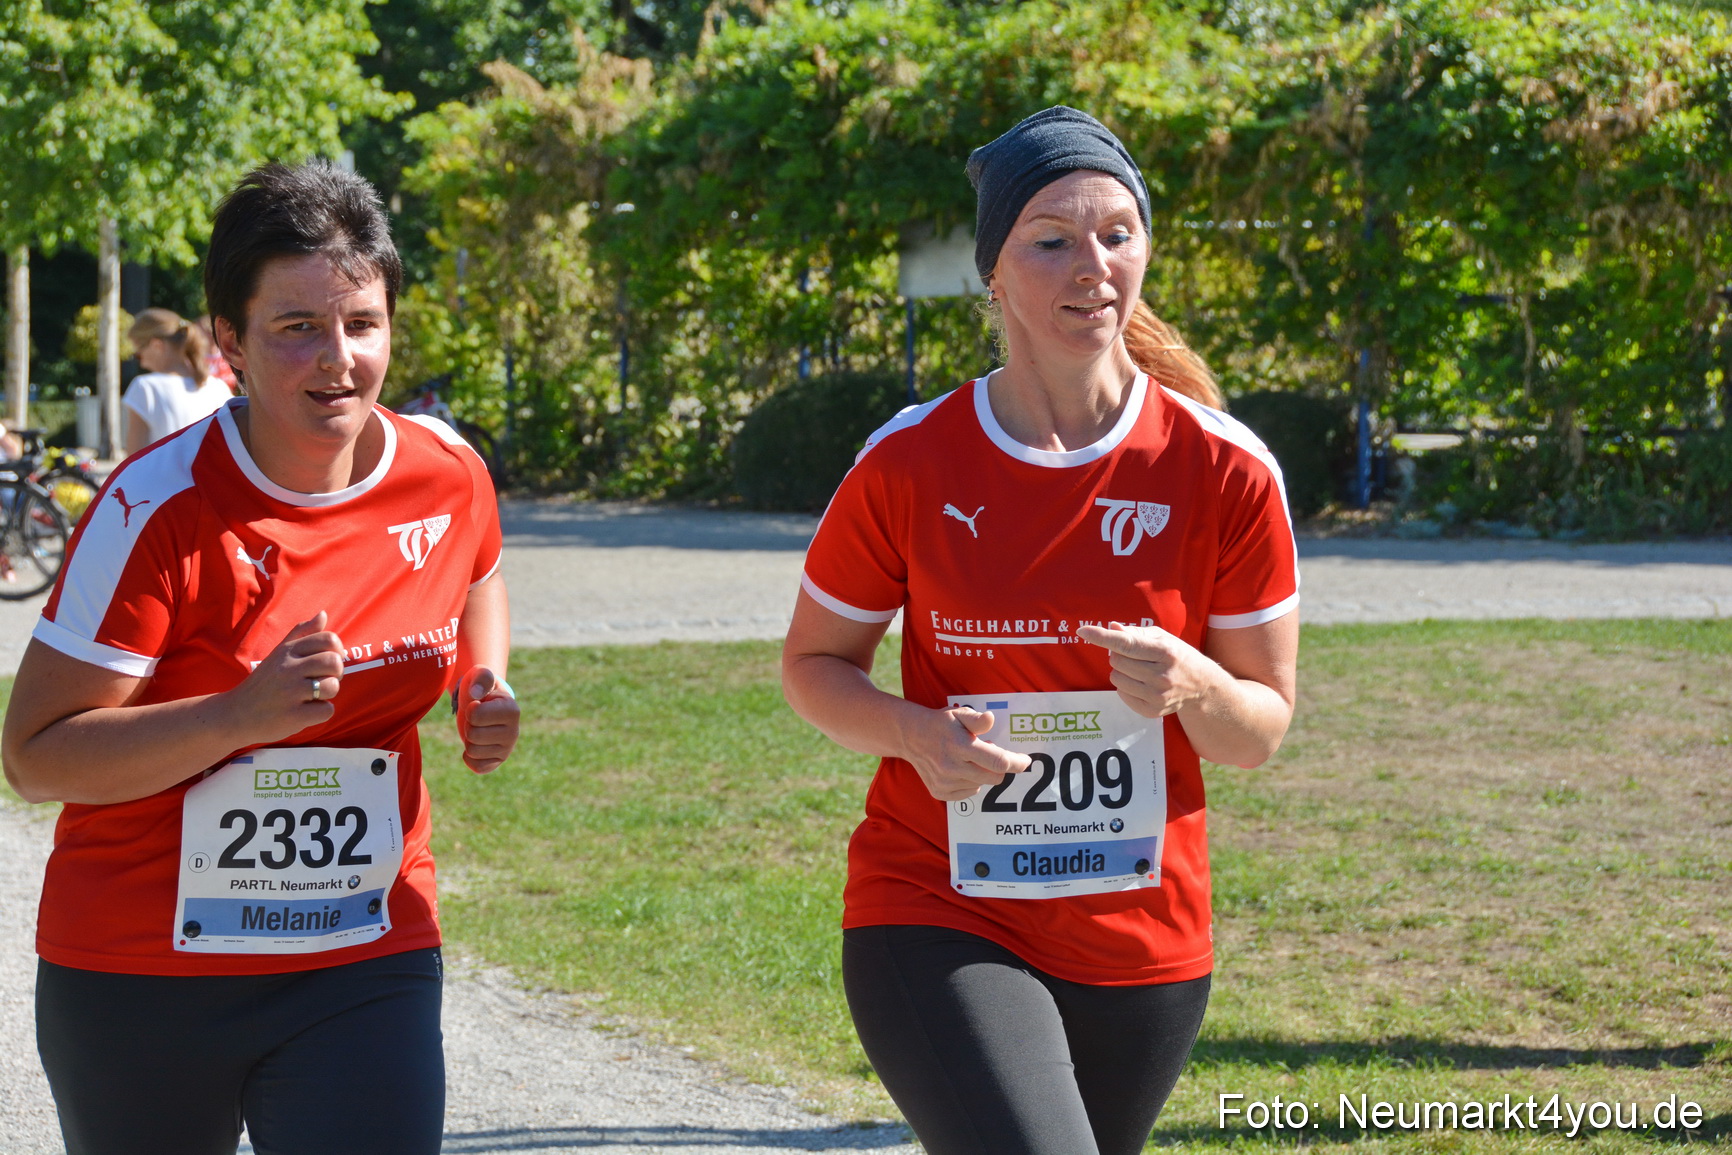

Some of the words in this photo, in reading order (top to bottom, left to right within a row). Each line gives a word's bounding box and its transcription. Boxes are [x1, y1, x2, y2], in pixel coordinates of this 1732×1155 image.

[1058, 619, 1069, 632] &
[383, 640, 394, 653] &
[1061, 635, 1079, 645] DAS
[935, 643, 995, 660] Amberg
[388, 653, 408, 665] DAS
[1010, 711, 1101, 734] BOCK
[1010, 735, 1039, 743] inspired
[1041, 735, 1050, 743] by
[1072, 732, 1103, 741] concepts
[255, 767, 341, 790] BOCK
[981, 748, 1134, 813] 2209
[253, 791, 282, 799] inspired
[284, 791, 293, 799] by
[313, 789, 342, 798] concepts
[996, 824, 1040, 836] PARTL
[1044, 822, 1105, 835] Neumarkt
[217, 806, 372, 870] 2332
[1013, 849, 1105, 876] Claudia
[230, 879, 276, 891] PARTL
[280, 879, 343, 891] Neumarkt
[241, 905, 341, 931] Melanie
